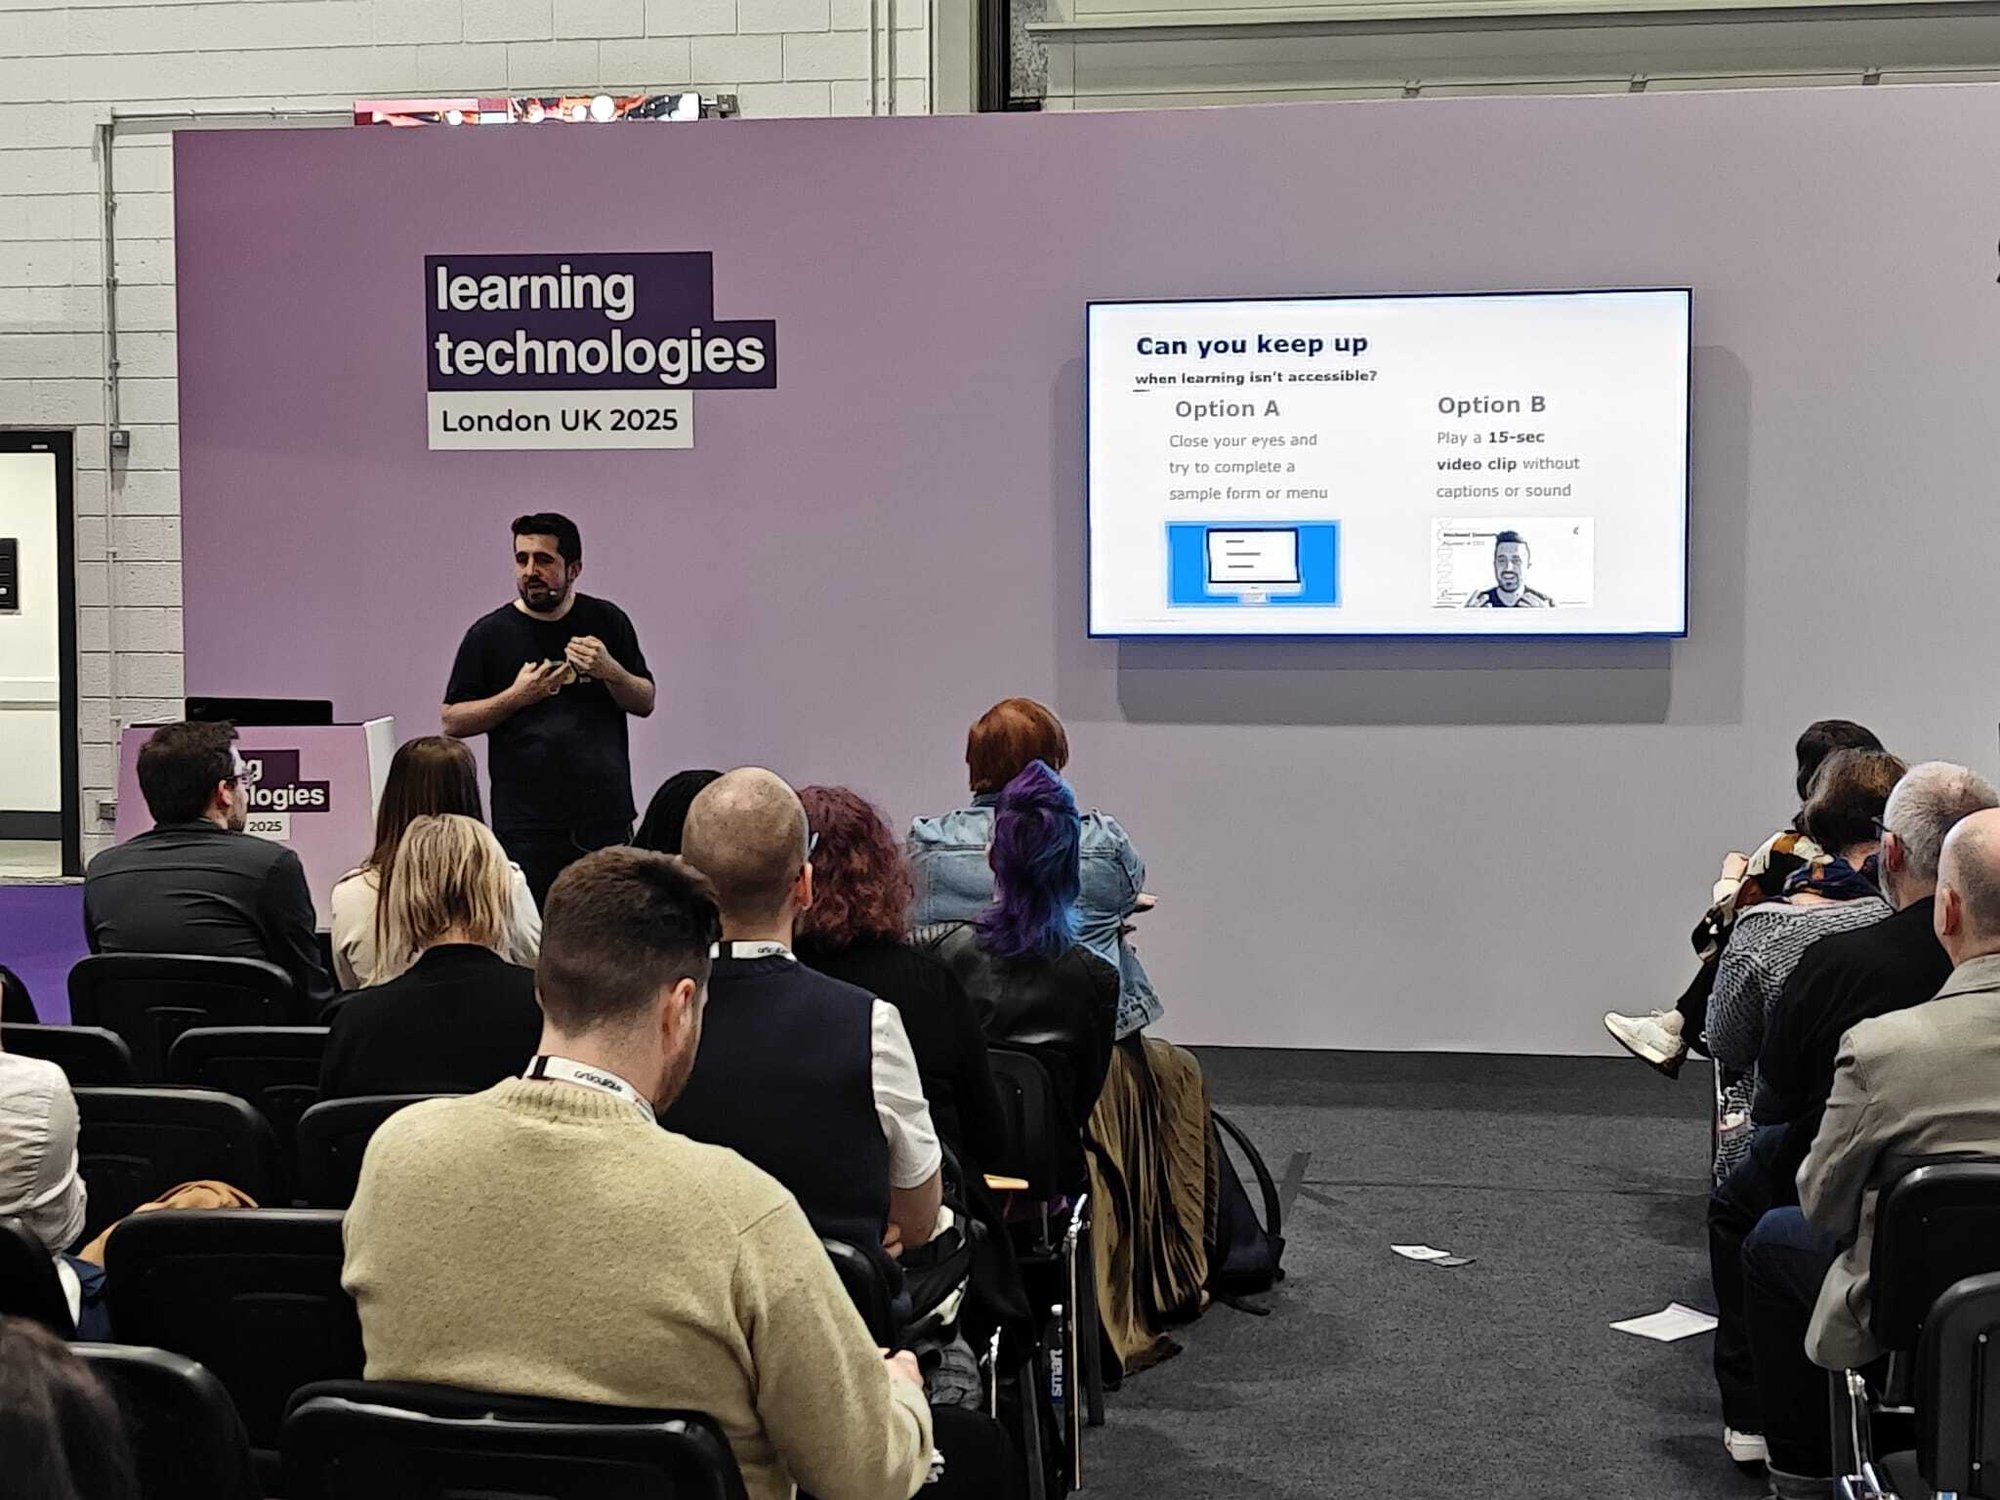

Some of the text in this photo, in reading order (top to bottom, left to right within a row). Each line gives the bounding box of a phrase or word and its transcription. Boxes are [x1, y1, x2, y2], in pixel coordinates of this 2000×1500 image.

[436, 264, 635, 321] learning
[1136, 334, 1368, 359] Can you keep up
[435, 328, 765, 385] technologies
[1135, 370, 1377, 386] when learning isn't accessible?
[1175, 399, 1280, 421] Option A
[1438, 395, 1546, 418] Option B
[442, 408, 678, 432] London UK 2025
[1169, 433, 1318, 450] Close your eyes and
[1437, 431, 1545, 446] Play a 15-sec
[1169, 460, 1296, 476] try to complete a
[1437, 457, 1580, 473] video clip without
[1169, 486, 1329, 502] sample form or menu
[1436, 483, 1571, 499] captions or sound
[249, 784, 325, 811] logies
[249, 821, 282, 832] 2025
[1049, 1348, 1063, 1397] smart
